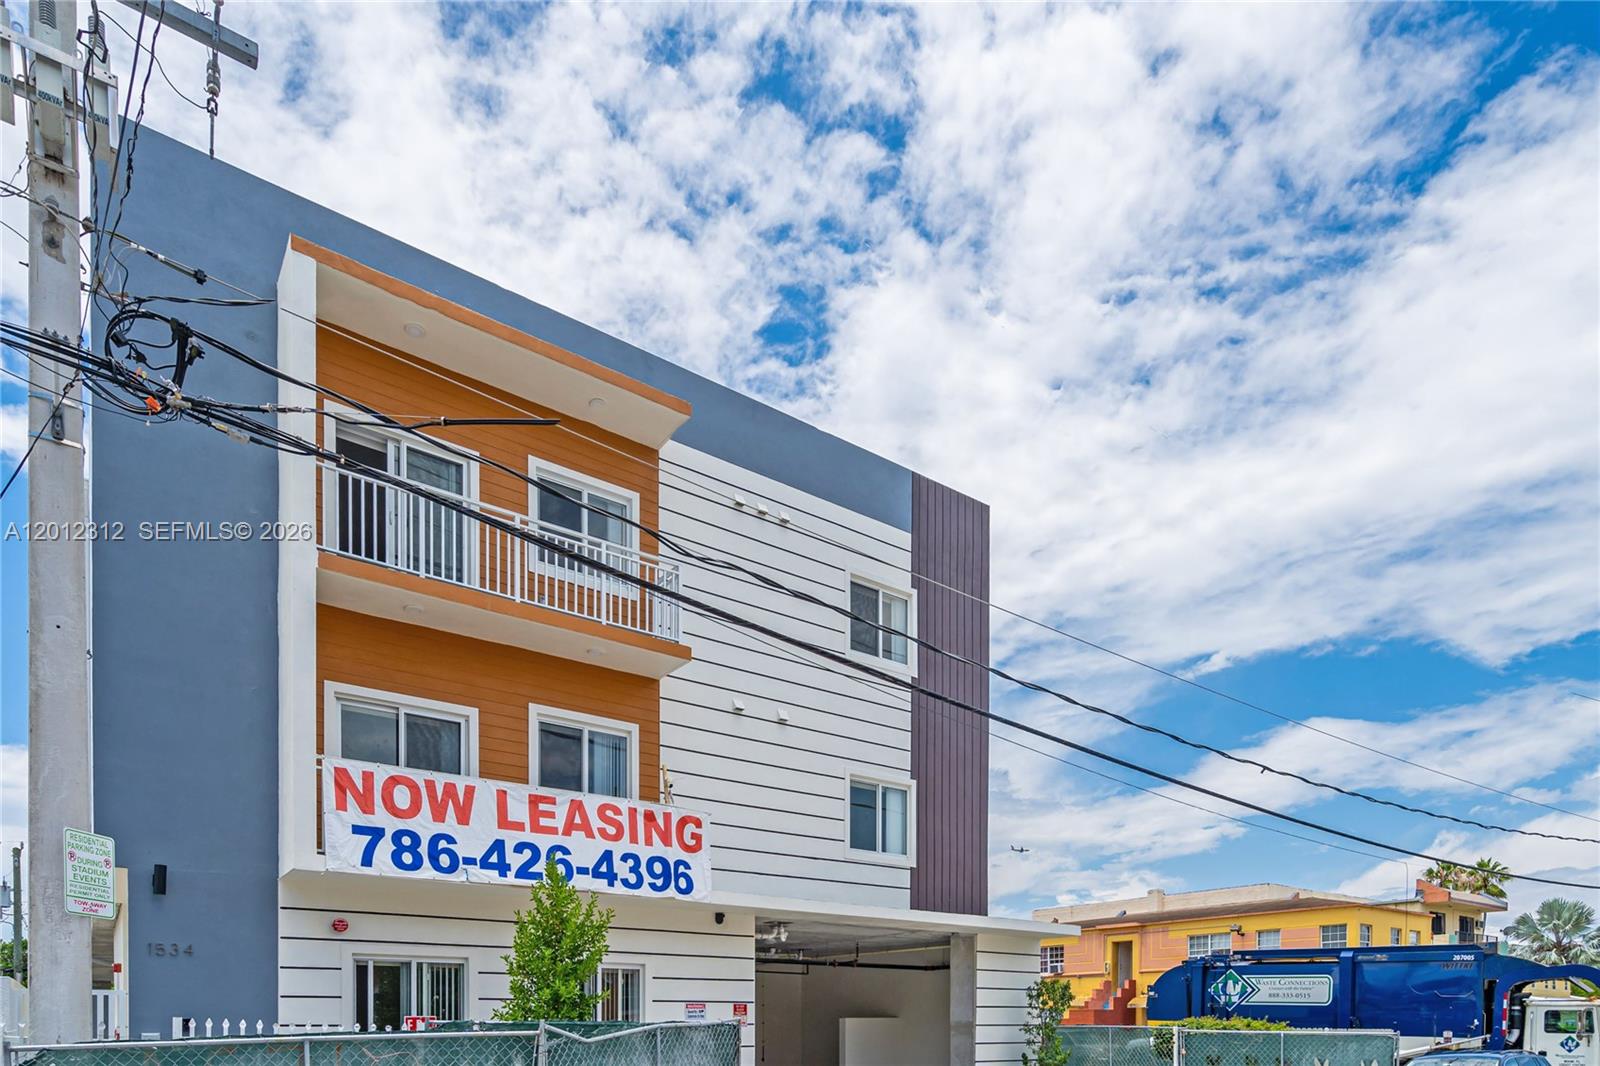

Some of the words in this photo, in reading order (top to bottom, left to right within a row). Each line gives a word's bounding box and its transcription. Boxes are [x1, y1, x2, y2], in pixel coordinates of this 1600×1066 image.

[332, 766, 476, 826] NOW
[496, 788, 703, 854] LEASING
[69, 833, 109, 849] RESIDENTIAL
[67, 842, 95, 855] PARKING
[95, 847, 111, 858] ZONE
[77, 857, 102, 868] DURING
[351, 824, 695, 896] 786-426-4396
[71, 864, 109, 878] STADIUM
[73, 873, 107, 886] EVENTS
[69, 883, 110, 894] RESIDENTIAL
[69, 889, 92, 898] PERMIT
[148, 943, 194, 957] 1534
[1255, 978, 1277, 986] WASTE
[1278, 978, 1329, 986] CONNECTIONS
